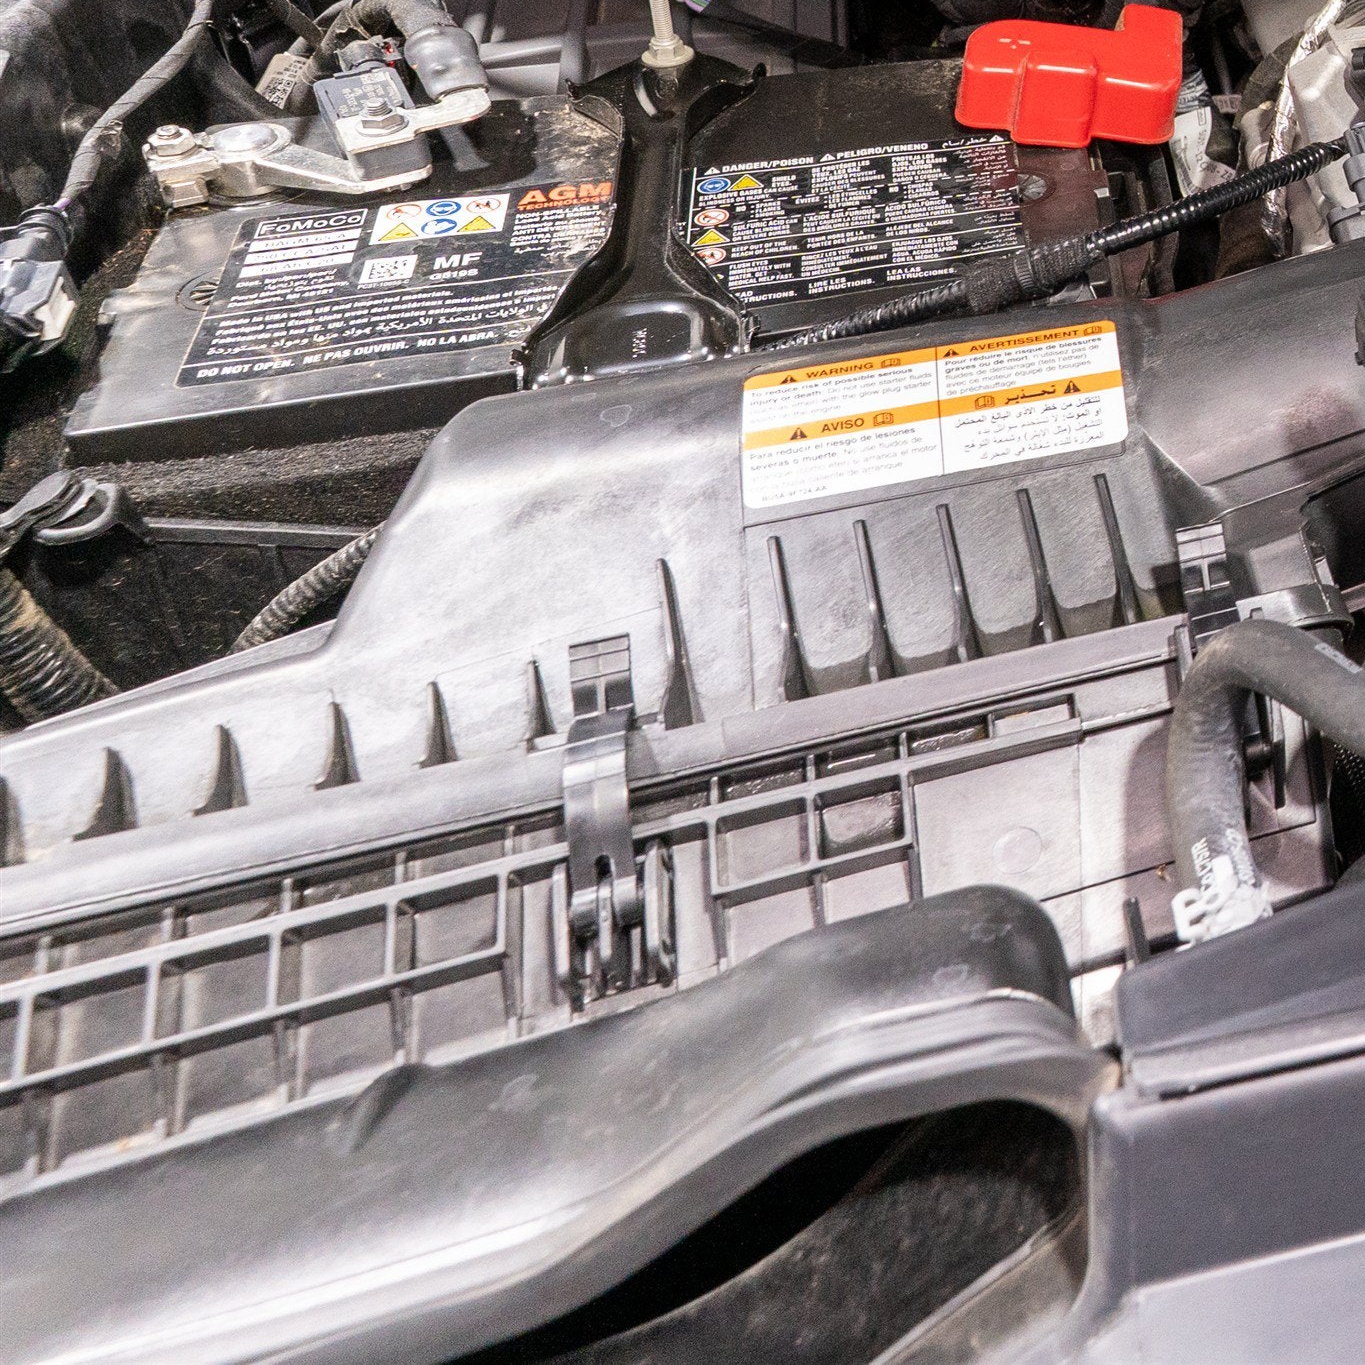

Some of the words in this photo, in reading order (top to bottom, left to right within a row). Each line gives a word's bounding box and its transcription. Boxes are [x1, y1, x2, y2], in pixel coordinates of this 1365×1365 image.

[836, 142, 928, 159] PELIGRO/VENENO
[722, 156, 813, 172] DANGER/POISON
[771, 174, 795, 182] SHIELD
[517, 179, 615, 205] AGM
[698, 192, 737, 201] EXPLOSIVE
[739, 188, 762, 196] GASES
[515, 194, 611, 211] TECHNOLOGY
[884, 203, 906, 211] ÁCIDO
[907, 198, 946, 208] SULFÚRICO
[831, 208, 875, 218] SULFURIQUE
[258, 213, 363, 234] FoMoCo
[733, 221, 767, 230] SULFURIC
[764, 244, 799, 253] CHILDREN.
[431, 251, 483, 270] MF
[808, 280, 828, 288] LIRE
[829, 277, 846, 285] LES
[886, 267, 957, 281] INSTRUCCIONES.
[808, 278, 875, 294] INSTRUCTIONS.
[219, 317, 250, 326] Made
[264, 312, 288, 320] USA
[288, 309, 314, 317] with
[331, 302, 352, 310] and
[352, 296, 400, 307] imported
[400, 289, 454, 301] materials.
[415, 336, 437, 347] NO
[437, 334, 458, 345] LA
[458, 329, 500, 343] ABRA.
[969, 329, 1078, 352] AVERTISSEMENT
[301, 353, 322, 364] NE
[323, 348, 353, 360] PAS
[352, 340, 411, 355] OUVRIR.
[944, 358, 966, 366] Pour
[969, 352, 1001, 362] réduire
[1015, 346, 1042, 356] risque
[1058, 336, 1101, 348] blessures
[195, 367, 219, 378] DO
[220, 363, 252, 374] NOT
[251, 358, 297, 371] OPEN.
[806, 362, 873, 378] WARNING
[945, 364, 975, 373] graves
[945, 371, 972, 380] fluides
[989, 361, 1035, 374] démarrage
[946, 380, 966, 388] avec
[982, 372, 1011, 382] moteur
[1014, 367, 1042, 378] équipé
[1058, 359, 1091, 370] bougies
[765, 385, 797, 395] reduce
[834, 373, 875, 385] possible
[878, 367, 912, 377] serious
[750, 397, 776, 408] injury
[878, 376, 907, 385] starter
[909, 372, 931, 380] fluids
[822, 395, 838, 403] with
[842, 392, 855, 400] the
[859, 389, 879, 398] glow
[881, 385, 900, 394] plug
[903, 380, 930, 390] starter
[1003, 384, 1057, 405] تحذير
[821, 417, 864, 433] AVISO
[750, 451, 772, 460] Para
[776, 444, 810, 455] reducir
[826, 436, 856, 449] riesgo
[875, 426, 915, 439] lesiones
[750, 460, 789, 471] severas
